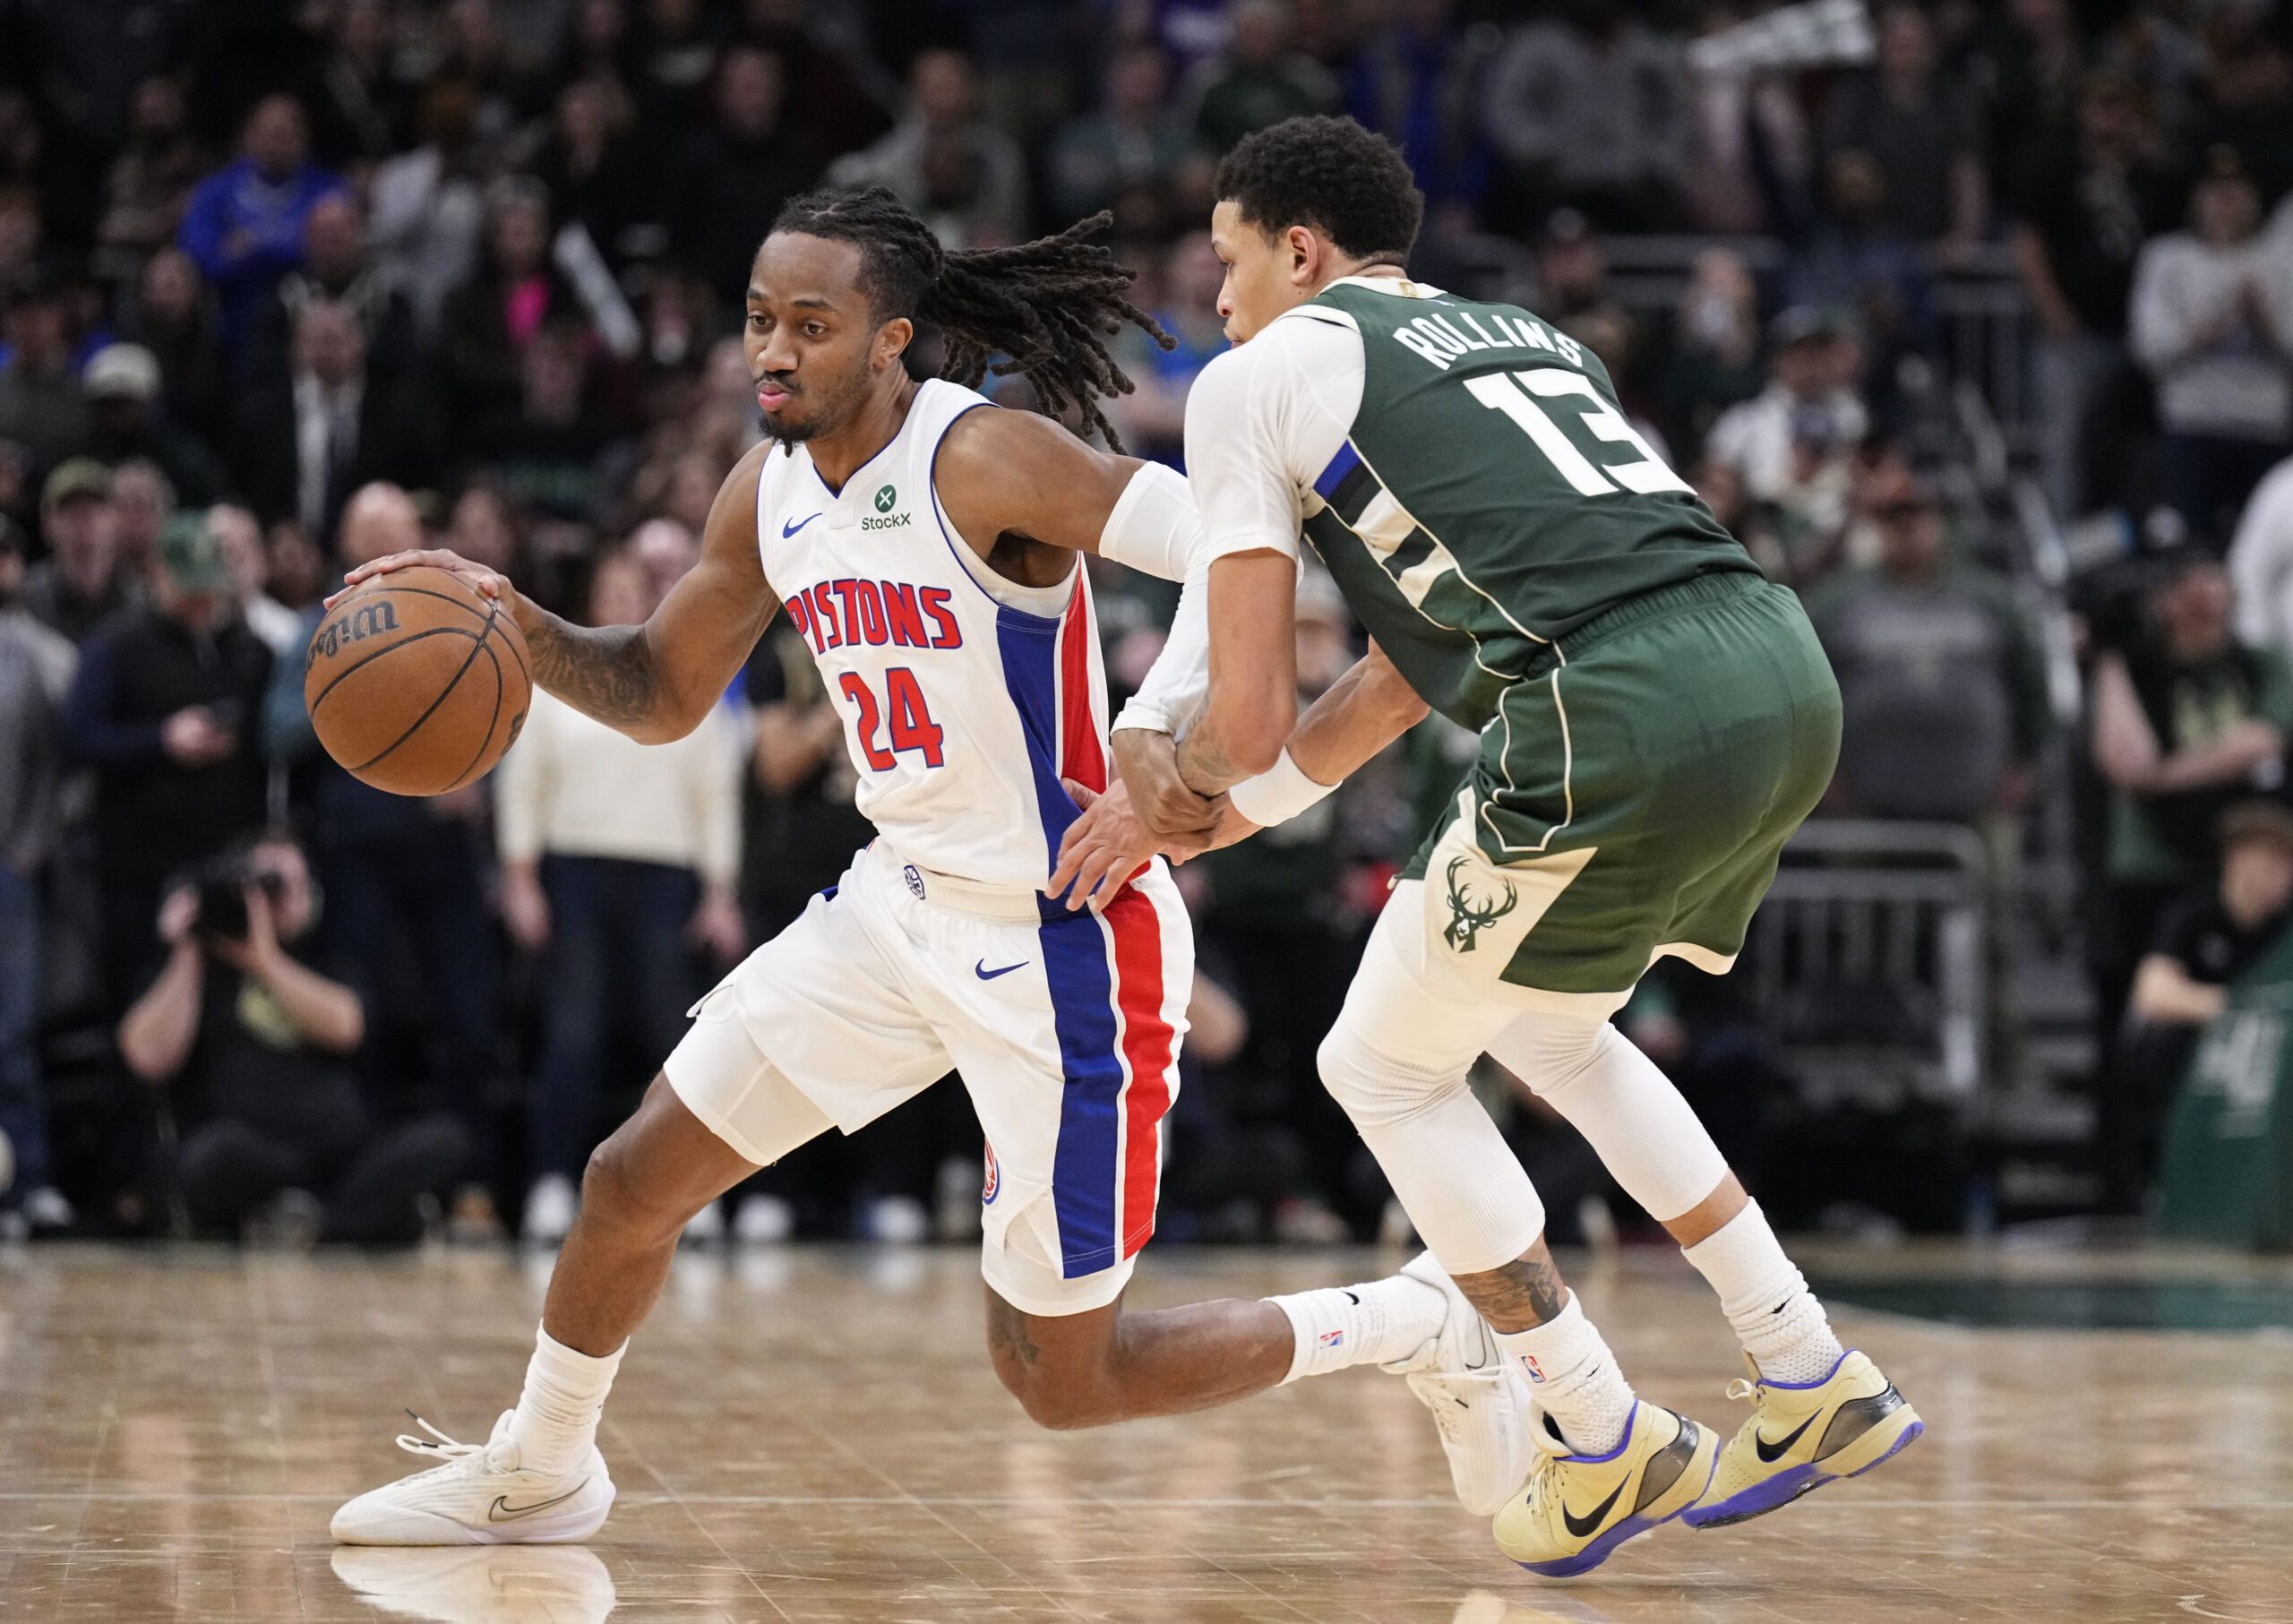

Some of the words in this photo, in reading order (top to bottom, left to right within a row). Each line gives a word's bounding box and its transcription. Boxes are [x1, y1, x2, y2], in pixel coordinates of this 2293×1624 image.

[1393, 313, 1583, 371] ROLLINS
[1463, 368, 1698, 497] 13
[862, 511, 911, 530] StockX
[785, 579, 963, 661] PISTONS
[839, 667, 944, 772] 24
